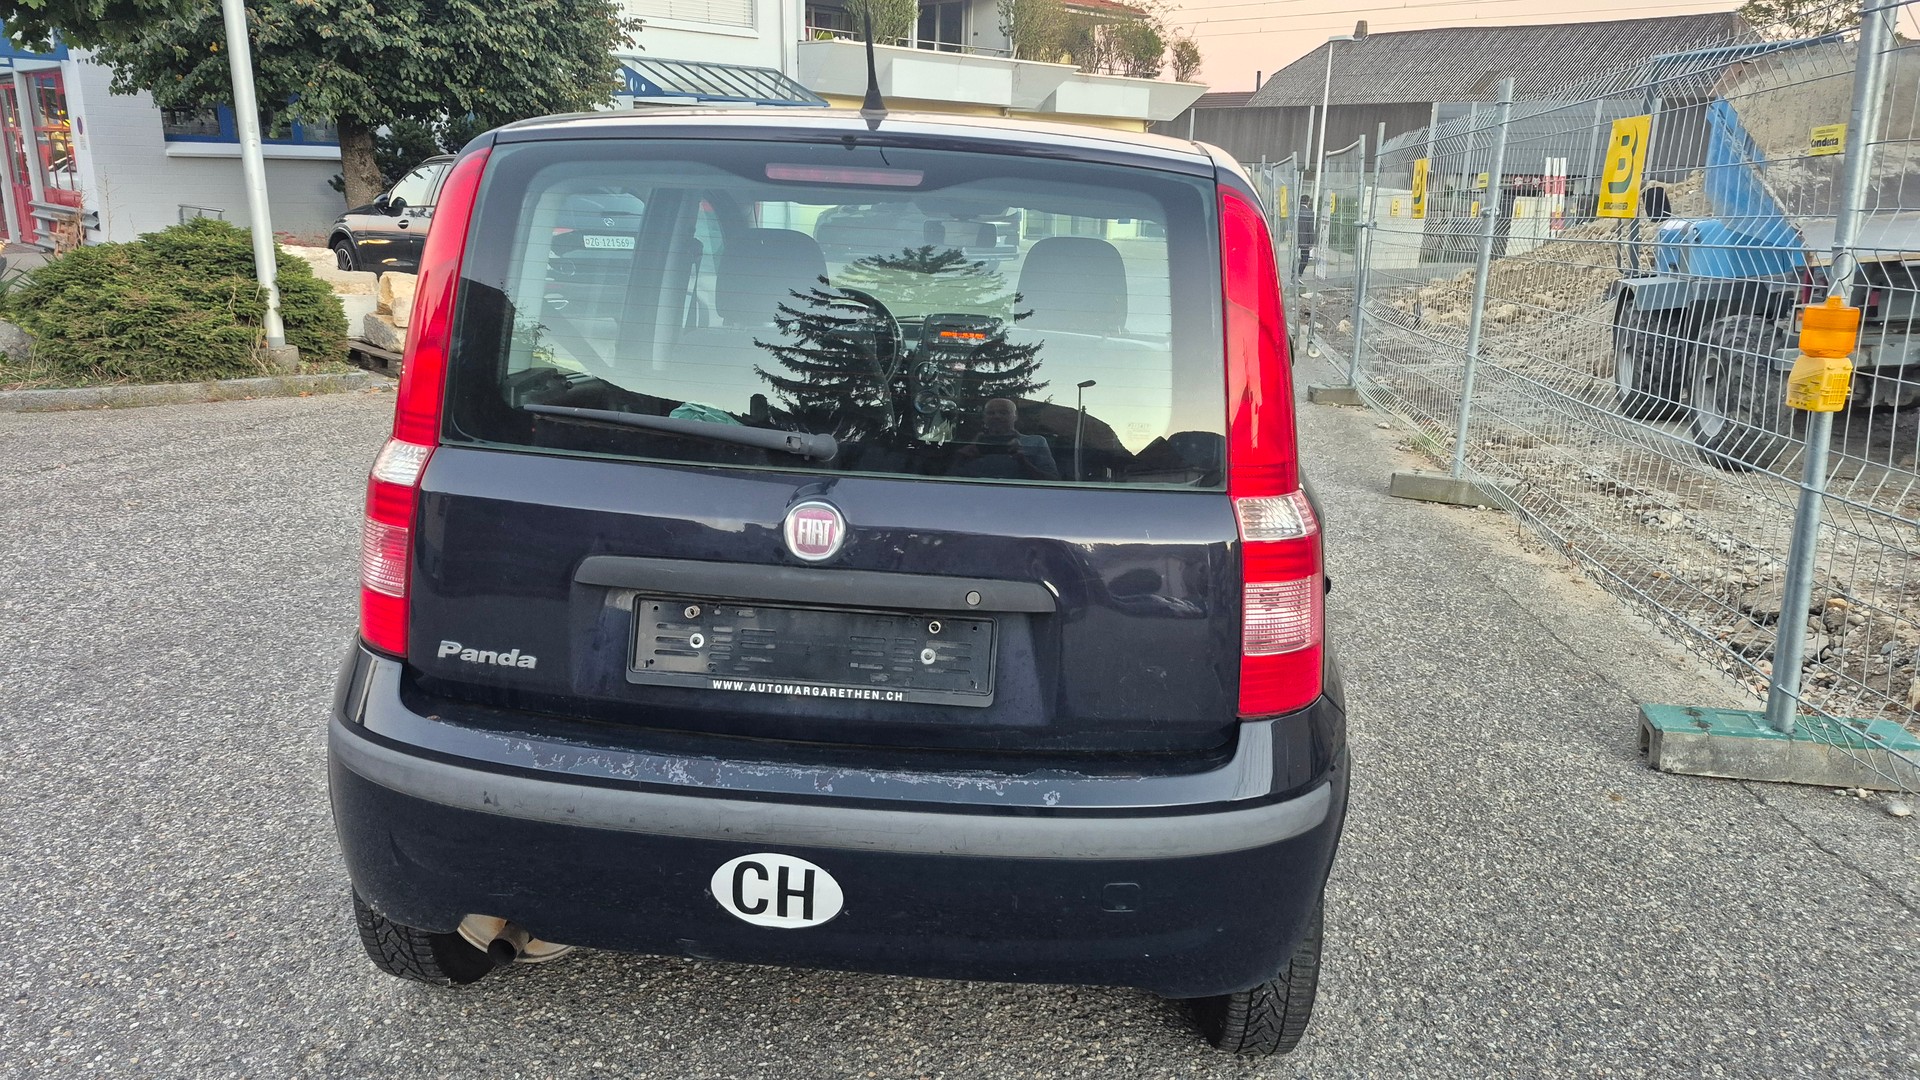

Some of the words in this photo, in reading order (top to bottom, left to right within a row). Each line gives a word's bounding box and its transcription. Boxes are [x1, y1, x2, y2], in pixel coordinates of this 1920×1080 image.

[797, 517, 833, 546] FIAT
[437, 639, 537, 669] Panda
[712, 679, 904, 702] WWW.AUTOMARGARETHEN.CH
[732, 860, 816, 921] CH
